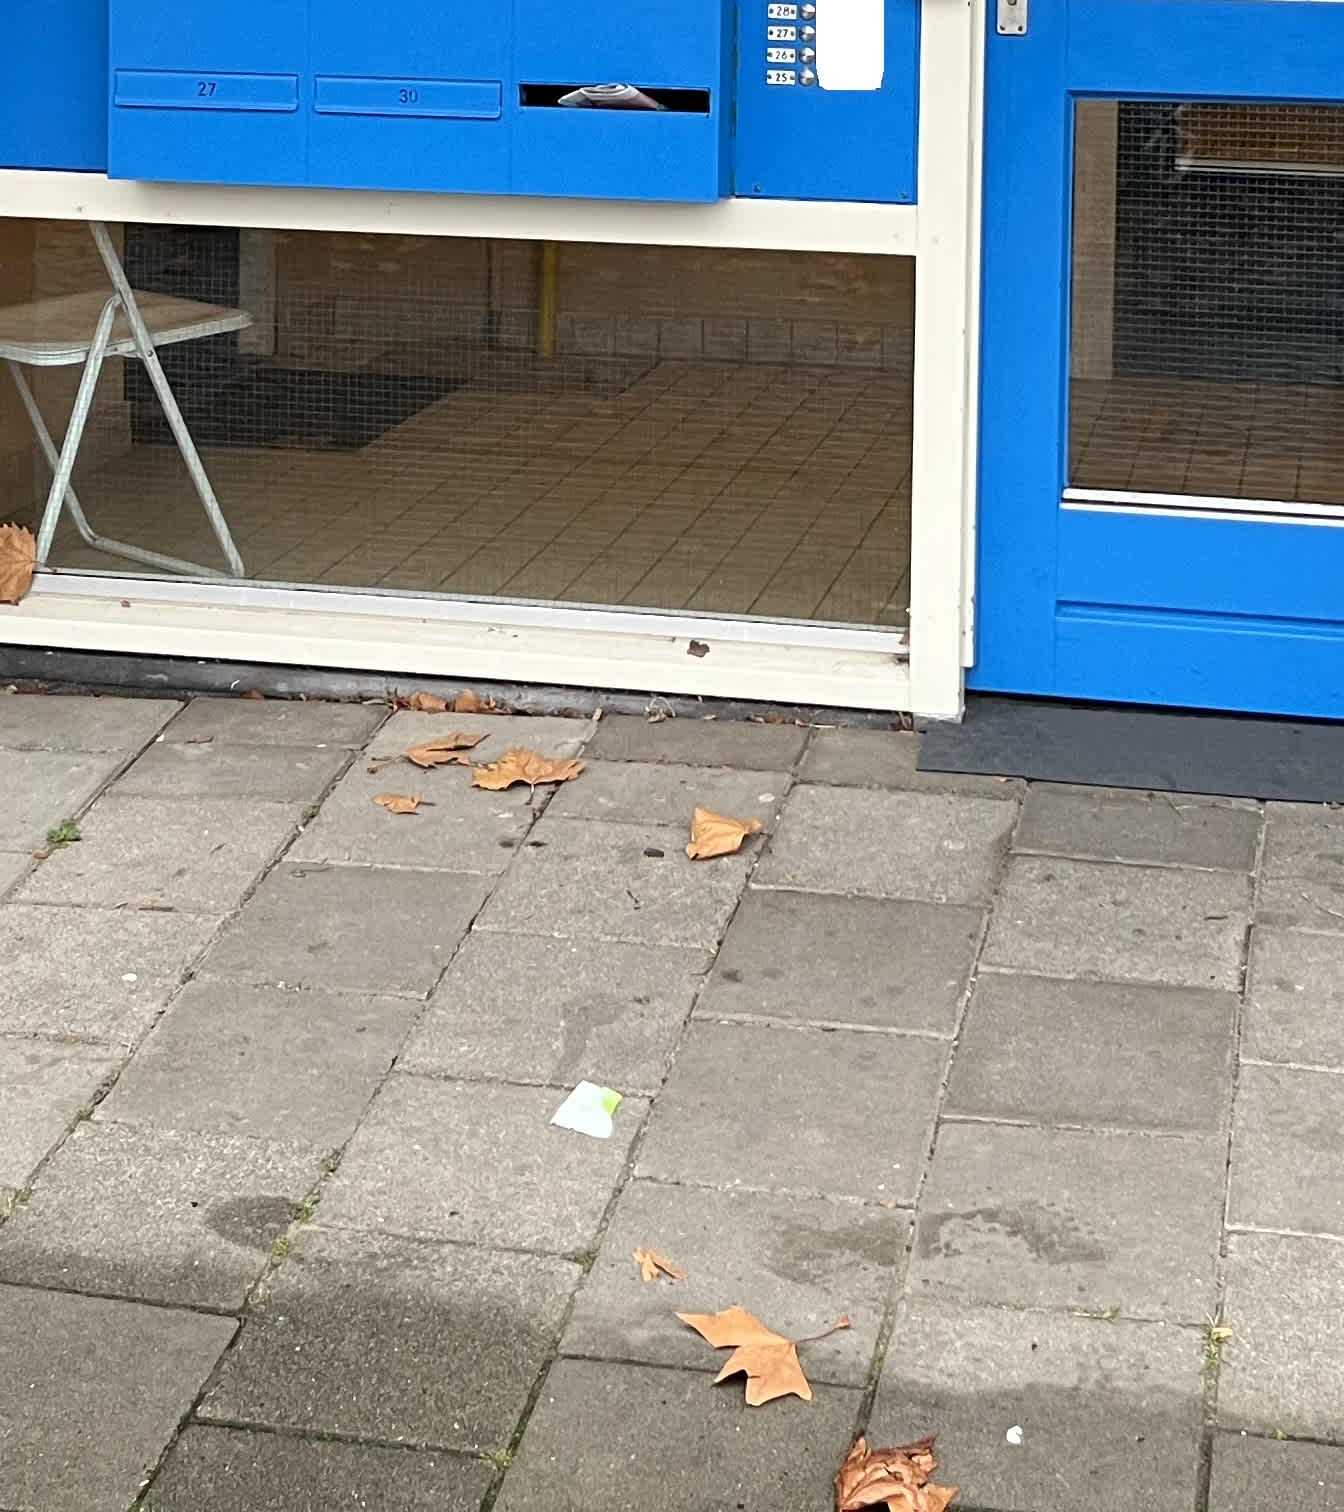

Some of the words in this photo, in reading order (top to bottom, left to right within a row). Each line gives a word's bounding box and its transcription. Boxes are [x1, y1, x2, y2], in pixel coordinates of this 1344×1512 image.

[777, 6, 790, 16] 28
[776, 28, 789, 38] 27
[775, 50, 787, 60] 26
[776, 72, 787, 82] 25
[198, 81, 216, 96] 27
[399, 88, 418, 103] 30
